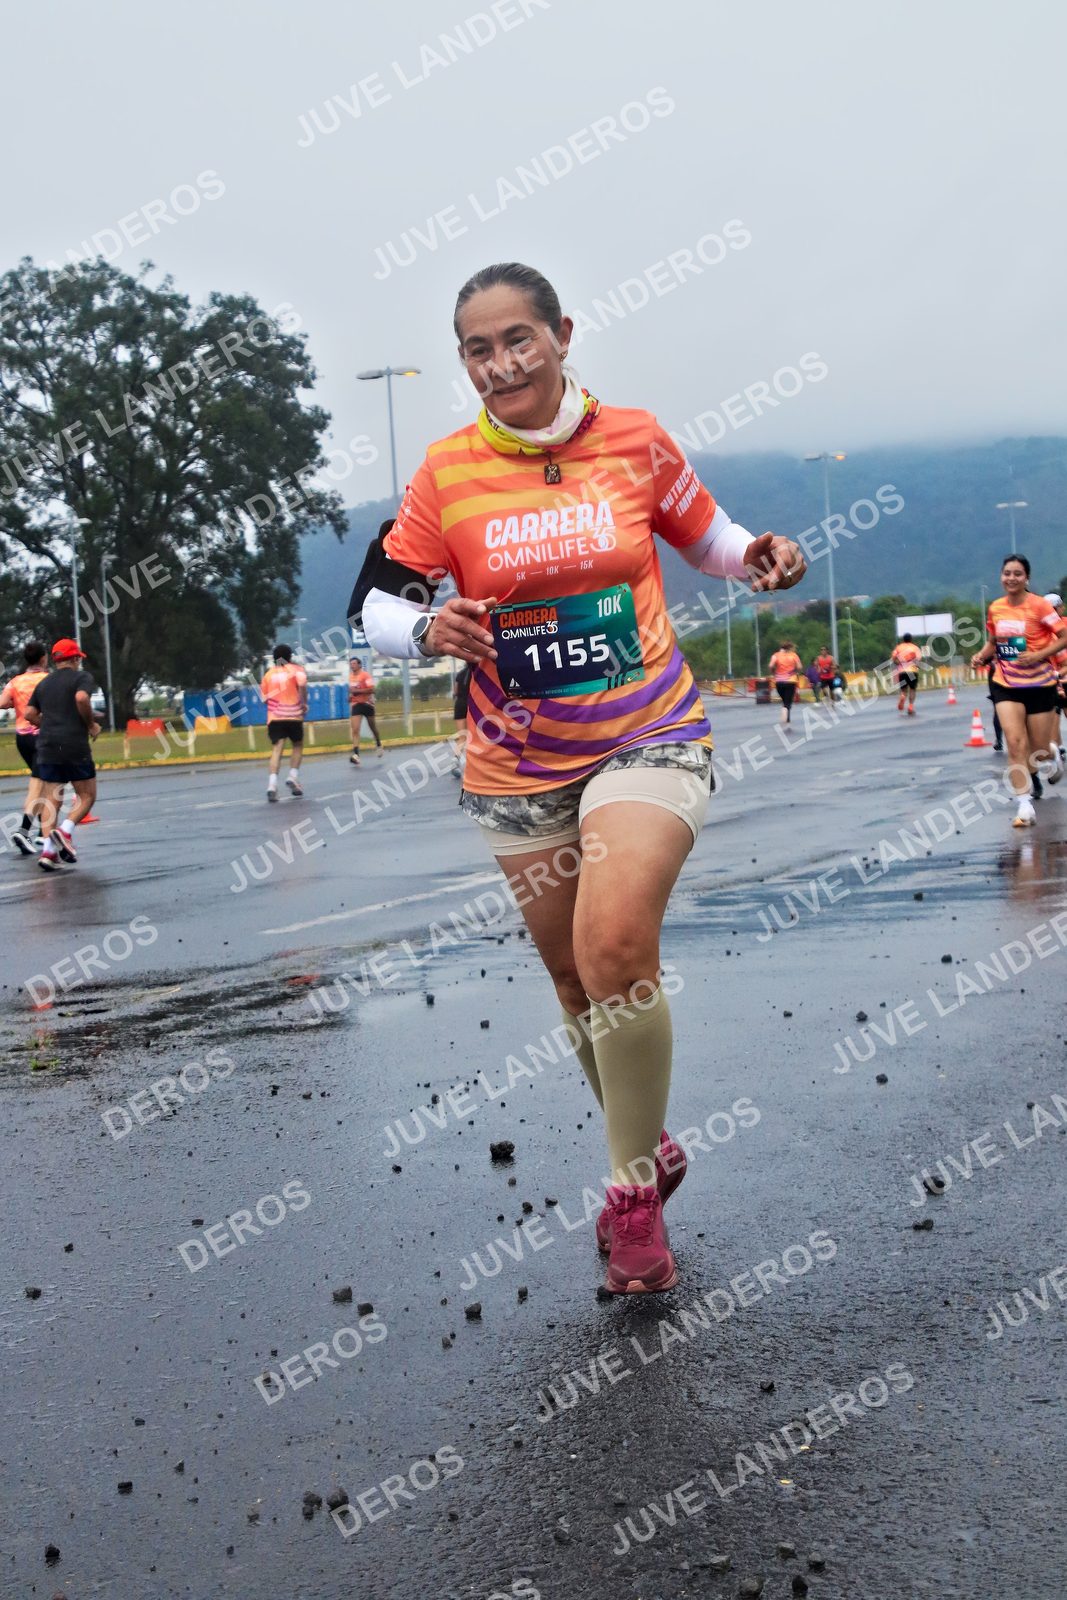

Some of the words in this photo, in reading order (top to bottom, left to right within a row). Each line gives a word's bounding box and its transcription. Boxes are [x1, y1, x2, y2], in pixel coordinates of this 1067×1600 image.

[485, 500, 614, 549] CARRERA
[487, 536, 590, 572] OMNILIFE
[546, 565, 559, 576] 10K
[499, 607, 558, 628] CARRERA
[597, 594, 622, 618] 10K
[501, 625, 546, 641] OMNILIFE
[524, 633, 610, 671] 1155
